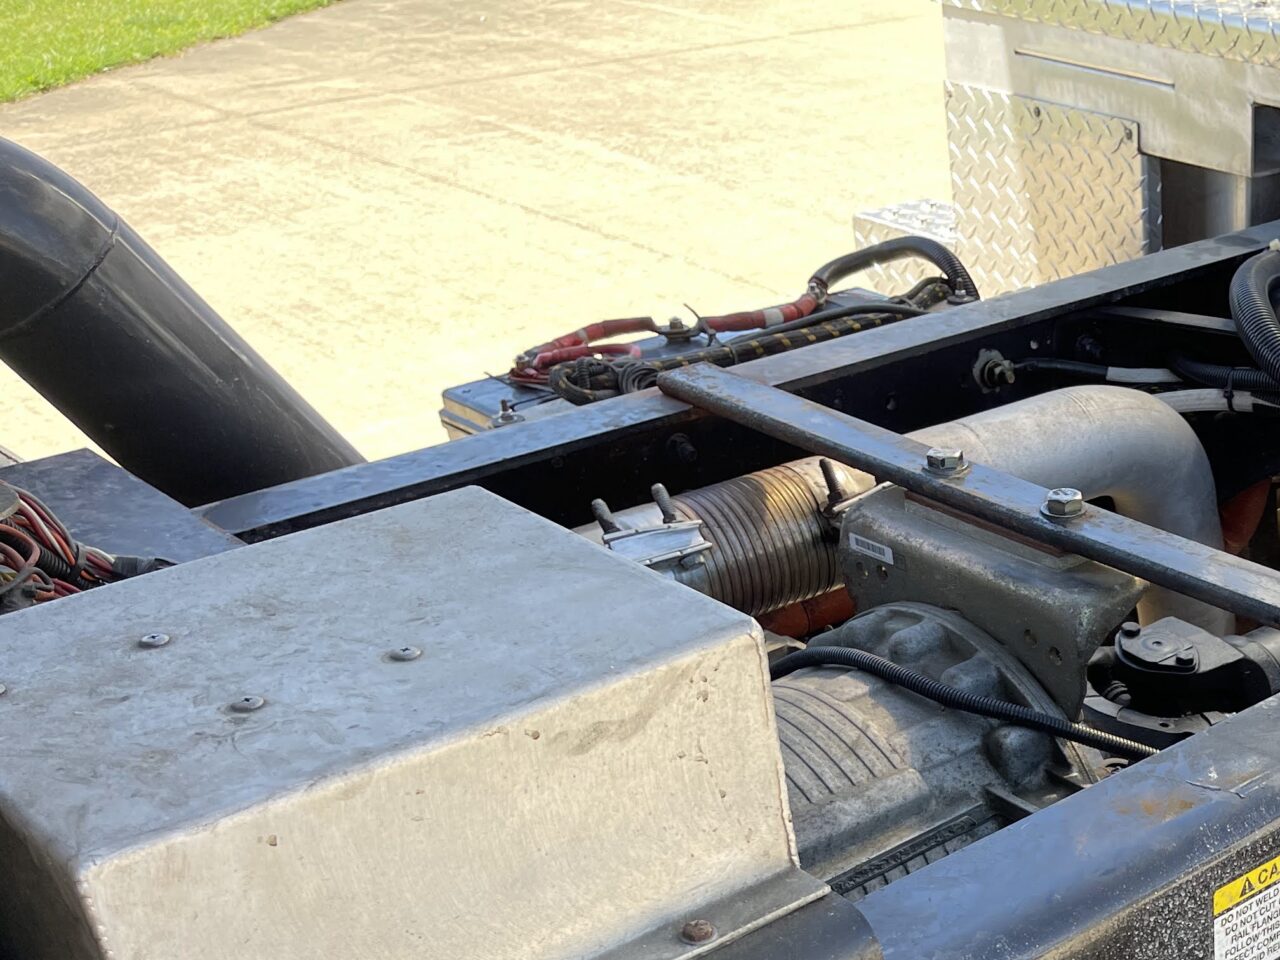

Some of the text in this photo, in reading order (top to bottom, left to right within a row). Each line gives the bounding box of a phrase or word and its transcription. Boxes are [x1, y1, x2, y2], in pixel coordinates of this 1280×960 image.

[1221, 914, 1234, 927] DO
[1236, 902, 1253, 918] NOT
[1256, 888, 1279, 909] WELD
[1225, 923, 1238, 936] DO
[1240, 911, 1258, 928] NOT
[1260, 901, 1276, 916] CUT
[1225, 933, 1261, 959] FOLLOW
[1262, 920, 1280, 936] THIS
[1231, 928, 1250, 944] RAIL
